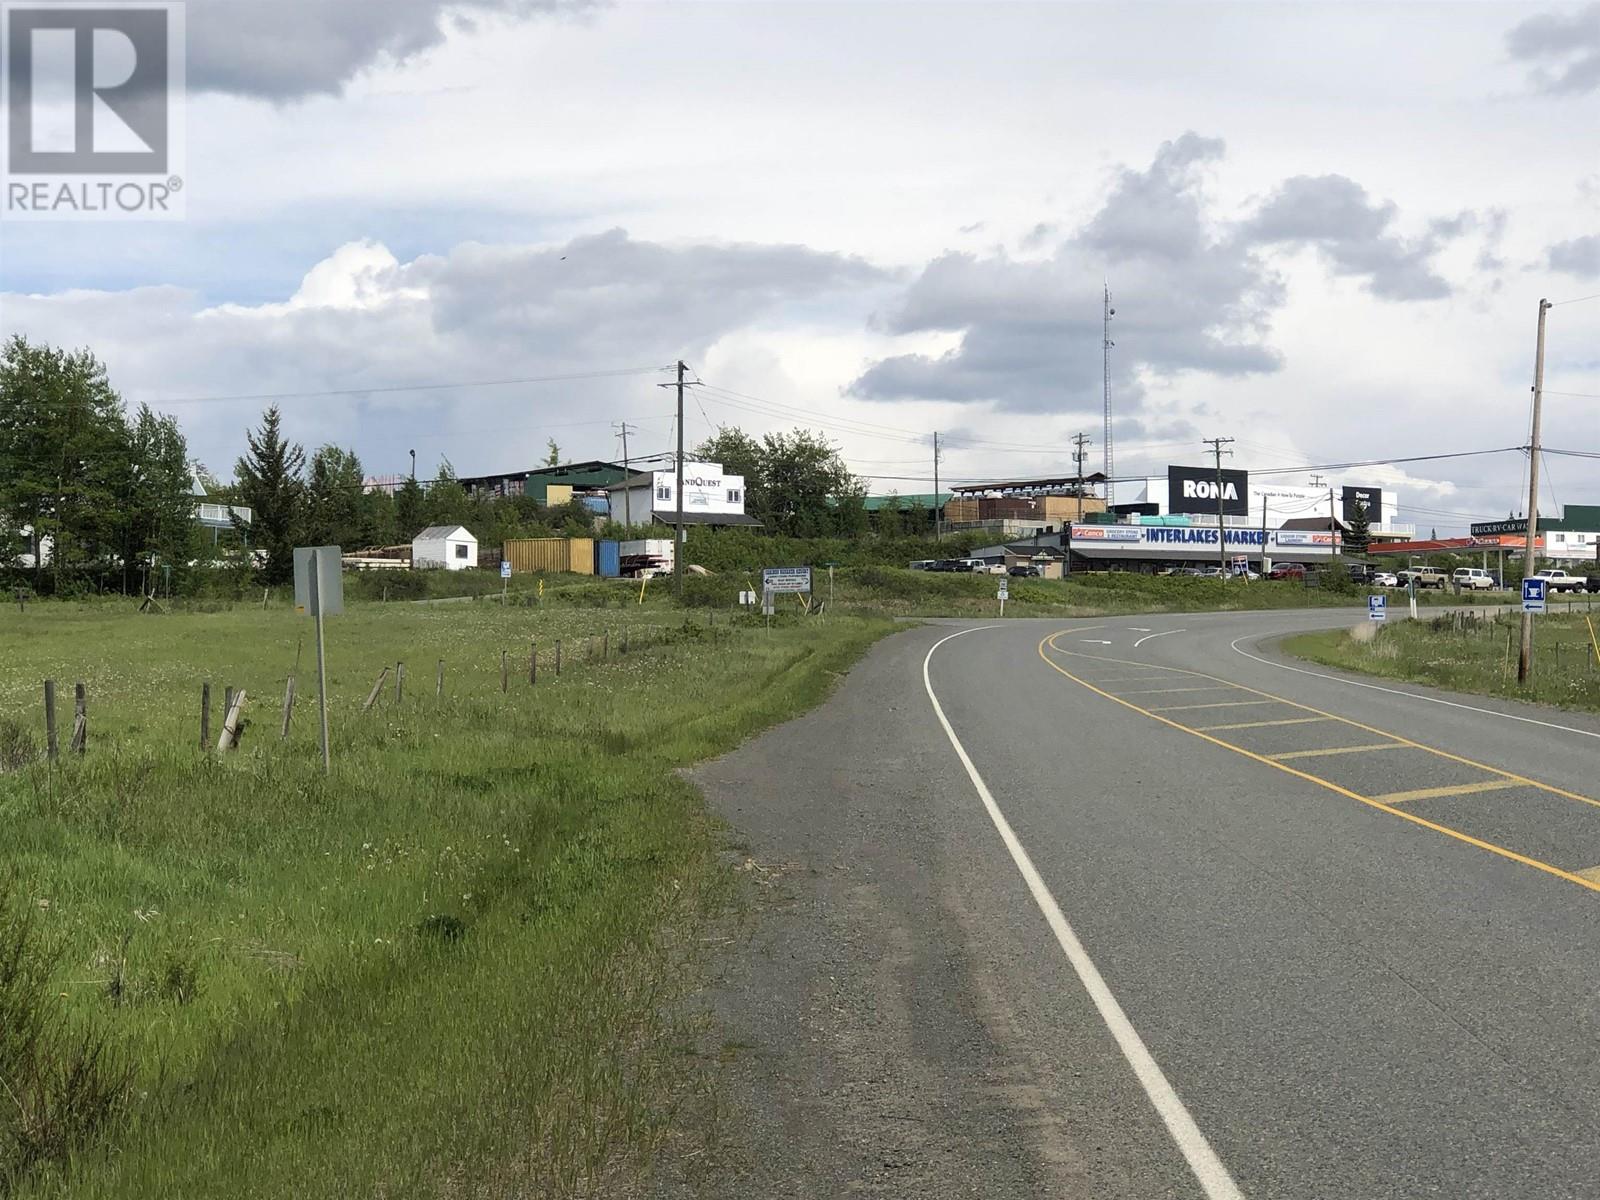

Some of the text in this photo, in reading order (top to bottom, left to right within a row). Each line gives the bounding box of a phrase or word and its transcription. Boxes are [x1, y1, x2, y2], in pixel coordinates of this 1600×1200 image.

[1183, 479, 1238, 500] RONA
[1146, 528, 1270, 546] INTERLAKES MARKET
